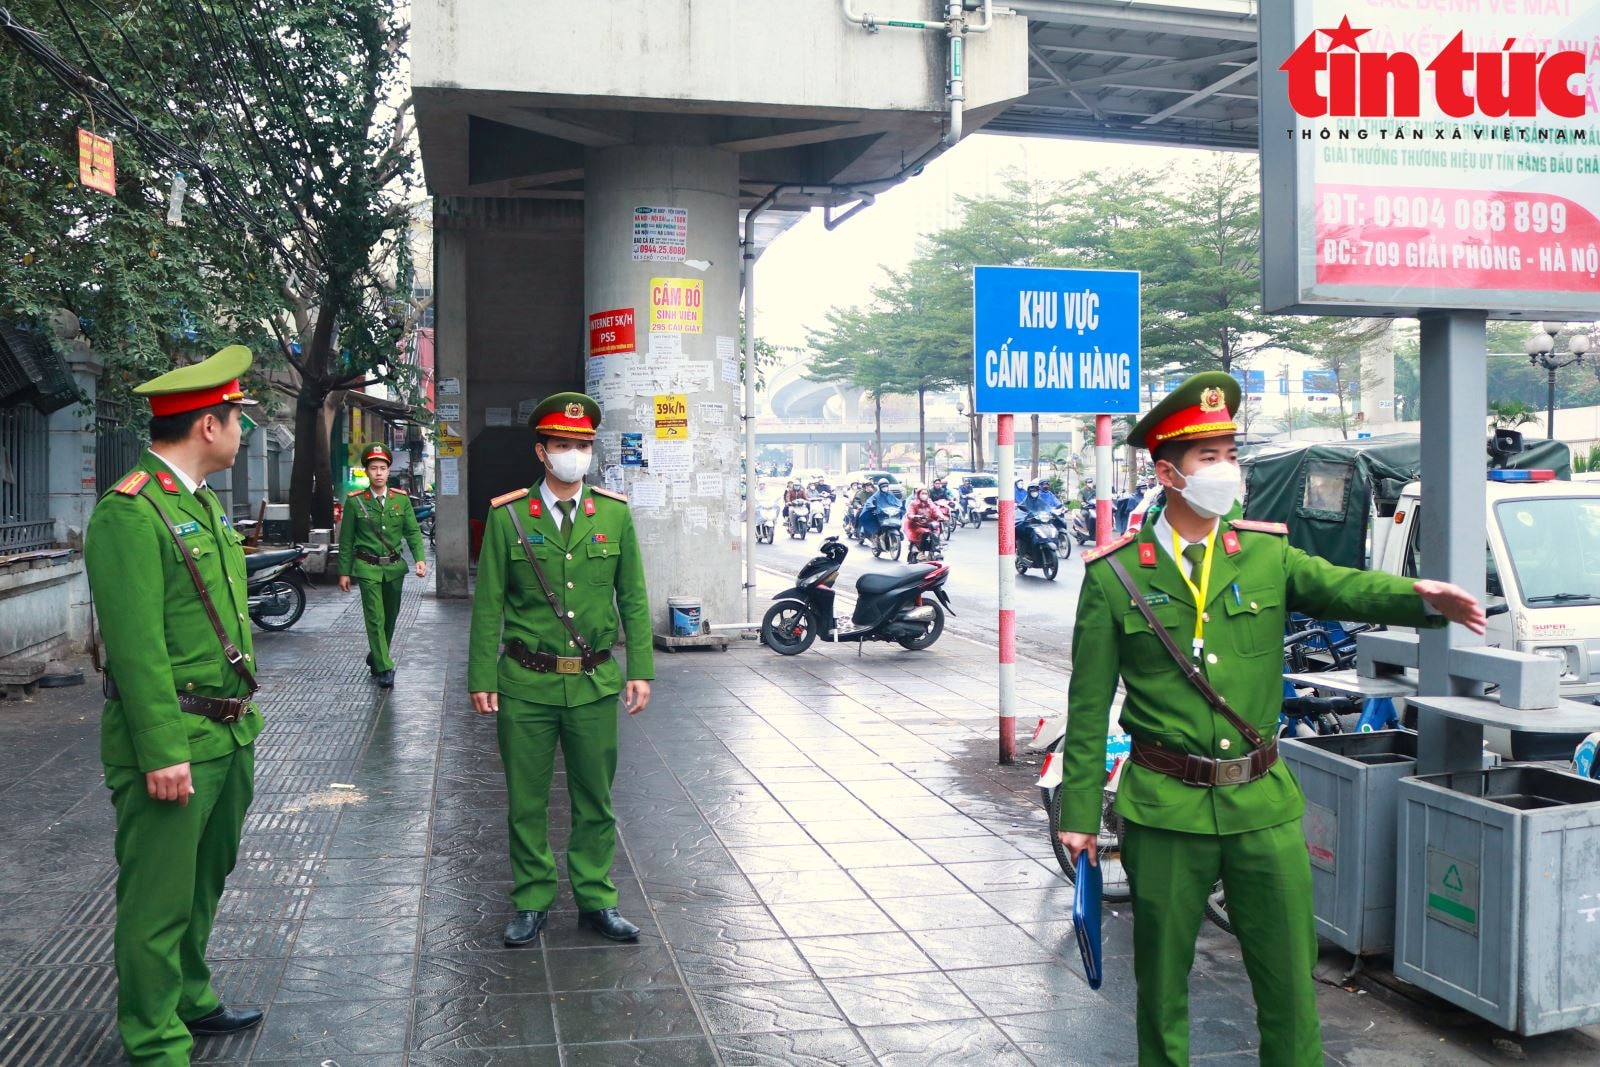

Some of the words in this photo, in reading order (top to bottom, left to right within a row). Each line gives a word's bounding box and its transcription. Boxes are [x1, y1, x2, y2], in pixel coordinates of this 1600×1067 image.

[1480, 152, 1494, 169] UY
[1517, 151, 1547, 172] HÀNG
[1323, 192, 1366, 225] ĐT:
[1374, 195, 1446, 229] 0904
[1454, 198, 1506, 231] 088
[1514, 201, 1567, 233] 899
[1323, 239, 1358, 265] ĐC:
[1362, 241, 1400, 267] 709
[1405, 234, 1447, 268] GIẢI
[1452, 239, 1521, 271] PHÓNG
[1539, 242, 1567, 272] HÀ
[1571, 243, 1599, 278] NỘ
[656, 309, 677, 320] SINH
[1019, 290, 1057, 329] KHU
[1064, 289, 1099, 335] VỰC
[600, 331, 616, 343] PS5
[652, 323, 666, 331] 295
[985, 337, 1028, 388] CẤM
[1034, 345, 1073, 389] BÁN
[1079, 346, 1130, 390] HÀNG
[656, 401, 685, 415] 39k/h
